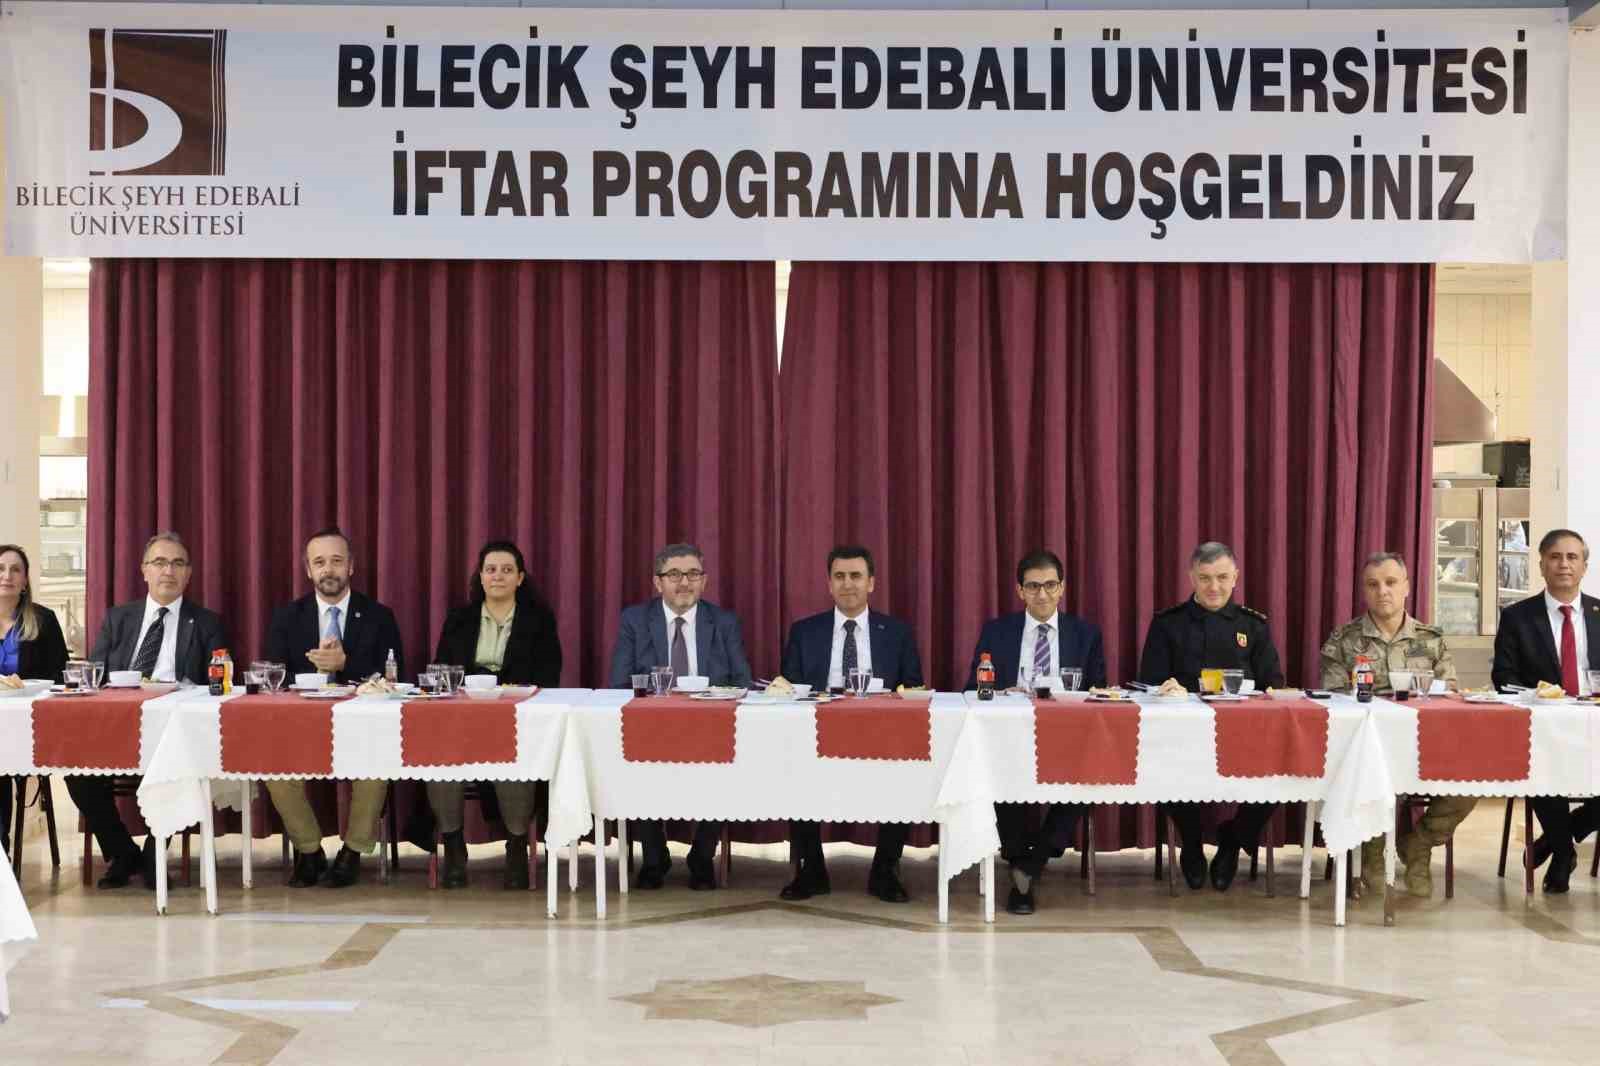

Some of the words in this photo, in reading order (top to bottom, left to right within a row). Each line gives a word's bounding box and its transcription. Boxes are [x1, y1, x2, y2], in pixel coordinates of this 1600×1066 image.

[338, 25, 590, 109] BİLECİK
[610, 44, 776, 129] ŞEYH
[801, 28, 1066, 110] EDEBALİ
[1092, 29, 1528, 114] ÜNİVERSİTESİ
[16, 183, 116, 207] BİLECİK
[122, 186, 184, 210] ŞEYH
[196, 182, 301, 206] EDEBALİ
[393, 131, 570, 217] İFTAR
[593, 150, 1024, 219] PROGRAMINA
[1046, 135, 1475, 240] HOŞGELDİNİZ
[71, 211, 243, 236] ÜNİVERSİTESİ
